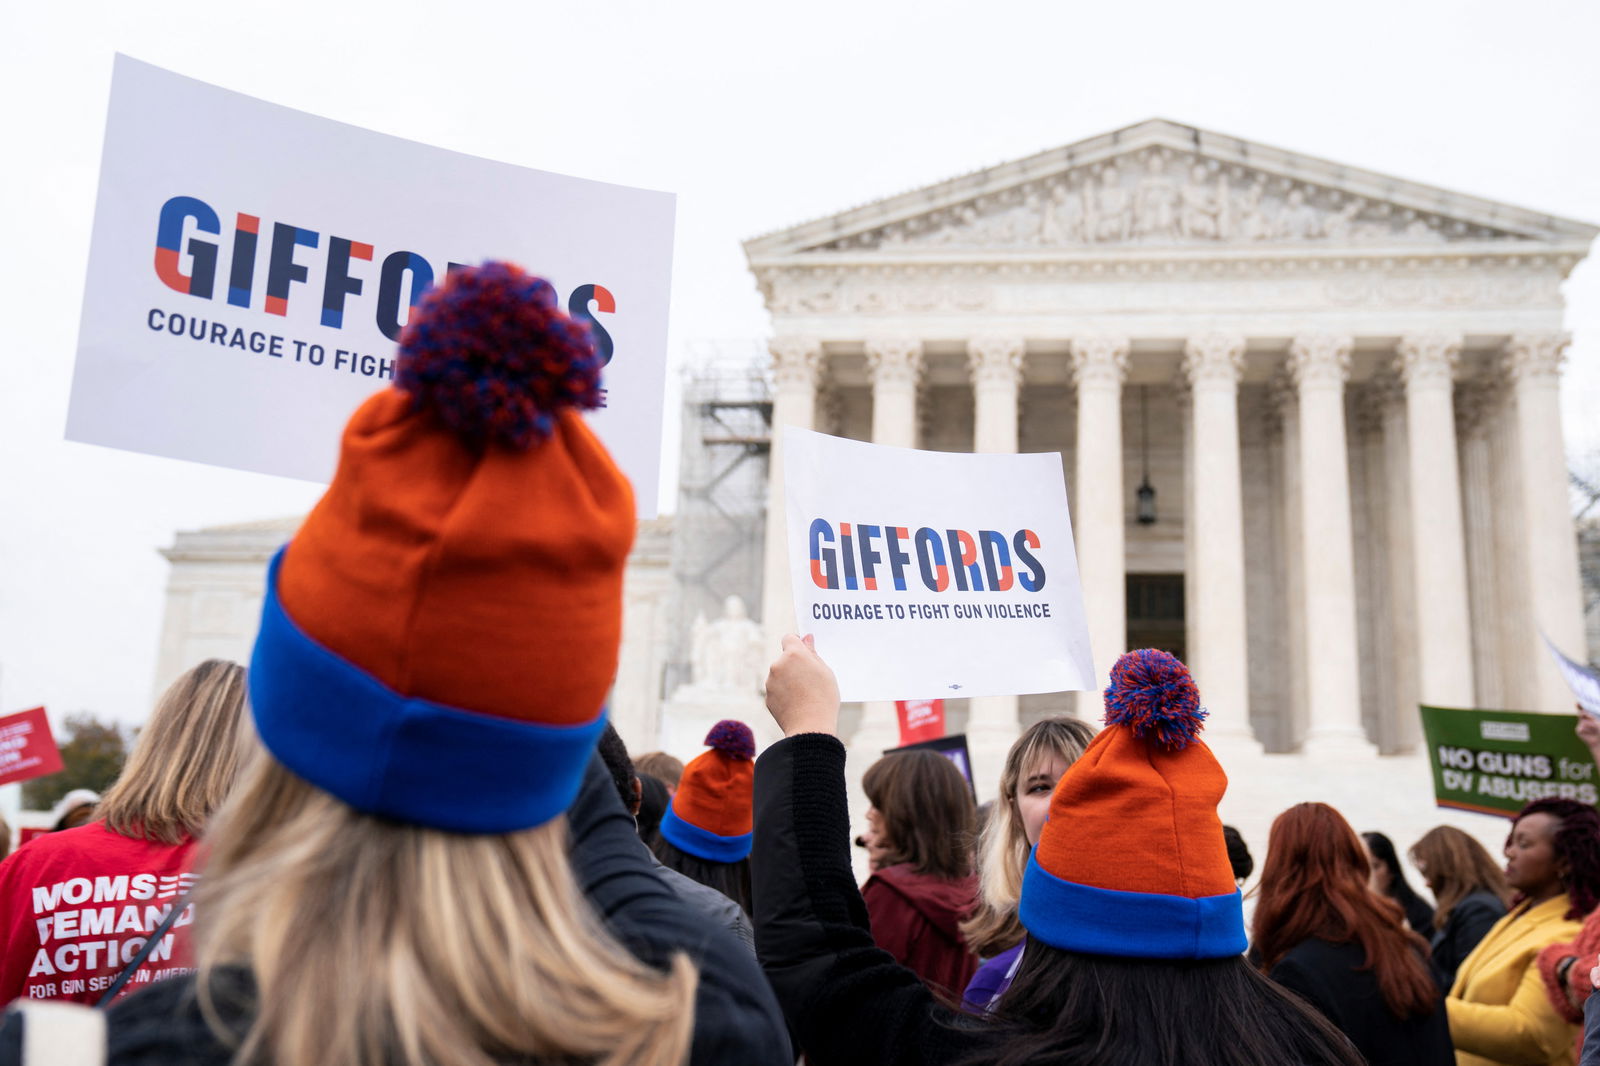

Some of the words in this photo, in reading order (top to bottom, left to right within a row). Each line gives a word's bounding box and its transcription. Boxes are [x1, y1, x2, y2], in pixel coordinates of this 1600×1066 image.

[154, 195, 616, 370] GIFFOS
[147, 308, 284, 358] COURAGE
[293, 340, 325, 367] TO
[334, 349, 397, 381] FIGH
[809, 518, 1046, 593] GIFFORDS
[812, 603, 883, 620] COURAGE
[885, 604, 905, 620] TO
[909, 603, 950, 620] FIGHT
[954, 603, 983, 619] GUN
[984, 603, 1051, 619] VIOLENCE
[1438, 746, 1474, 770] NO
[1477, 751, 1553, 779] GUNS
[1559, 757, 1594, 780] for
[1443, 769, 1473, 793] DV
[1478, 775, 1599, 806] ABUSERS
[32, 873, 157, 914] MOMS
[29, 933, 175, 978] ACTION
[29, 983, 57, 1000] FOR
[61, 979, 85, 995] GUN
[135, 969, 150, 983] IN
[153, 967, 200, 983] AMERI
